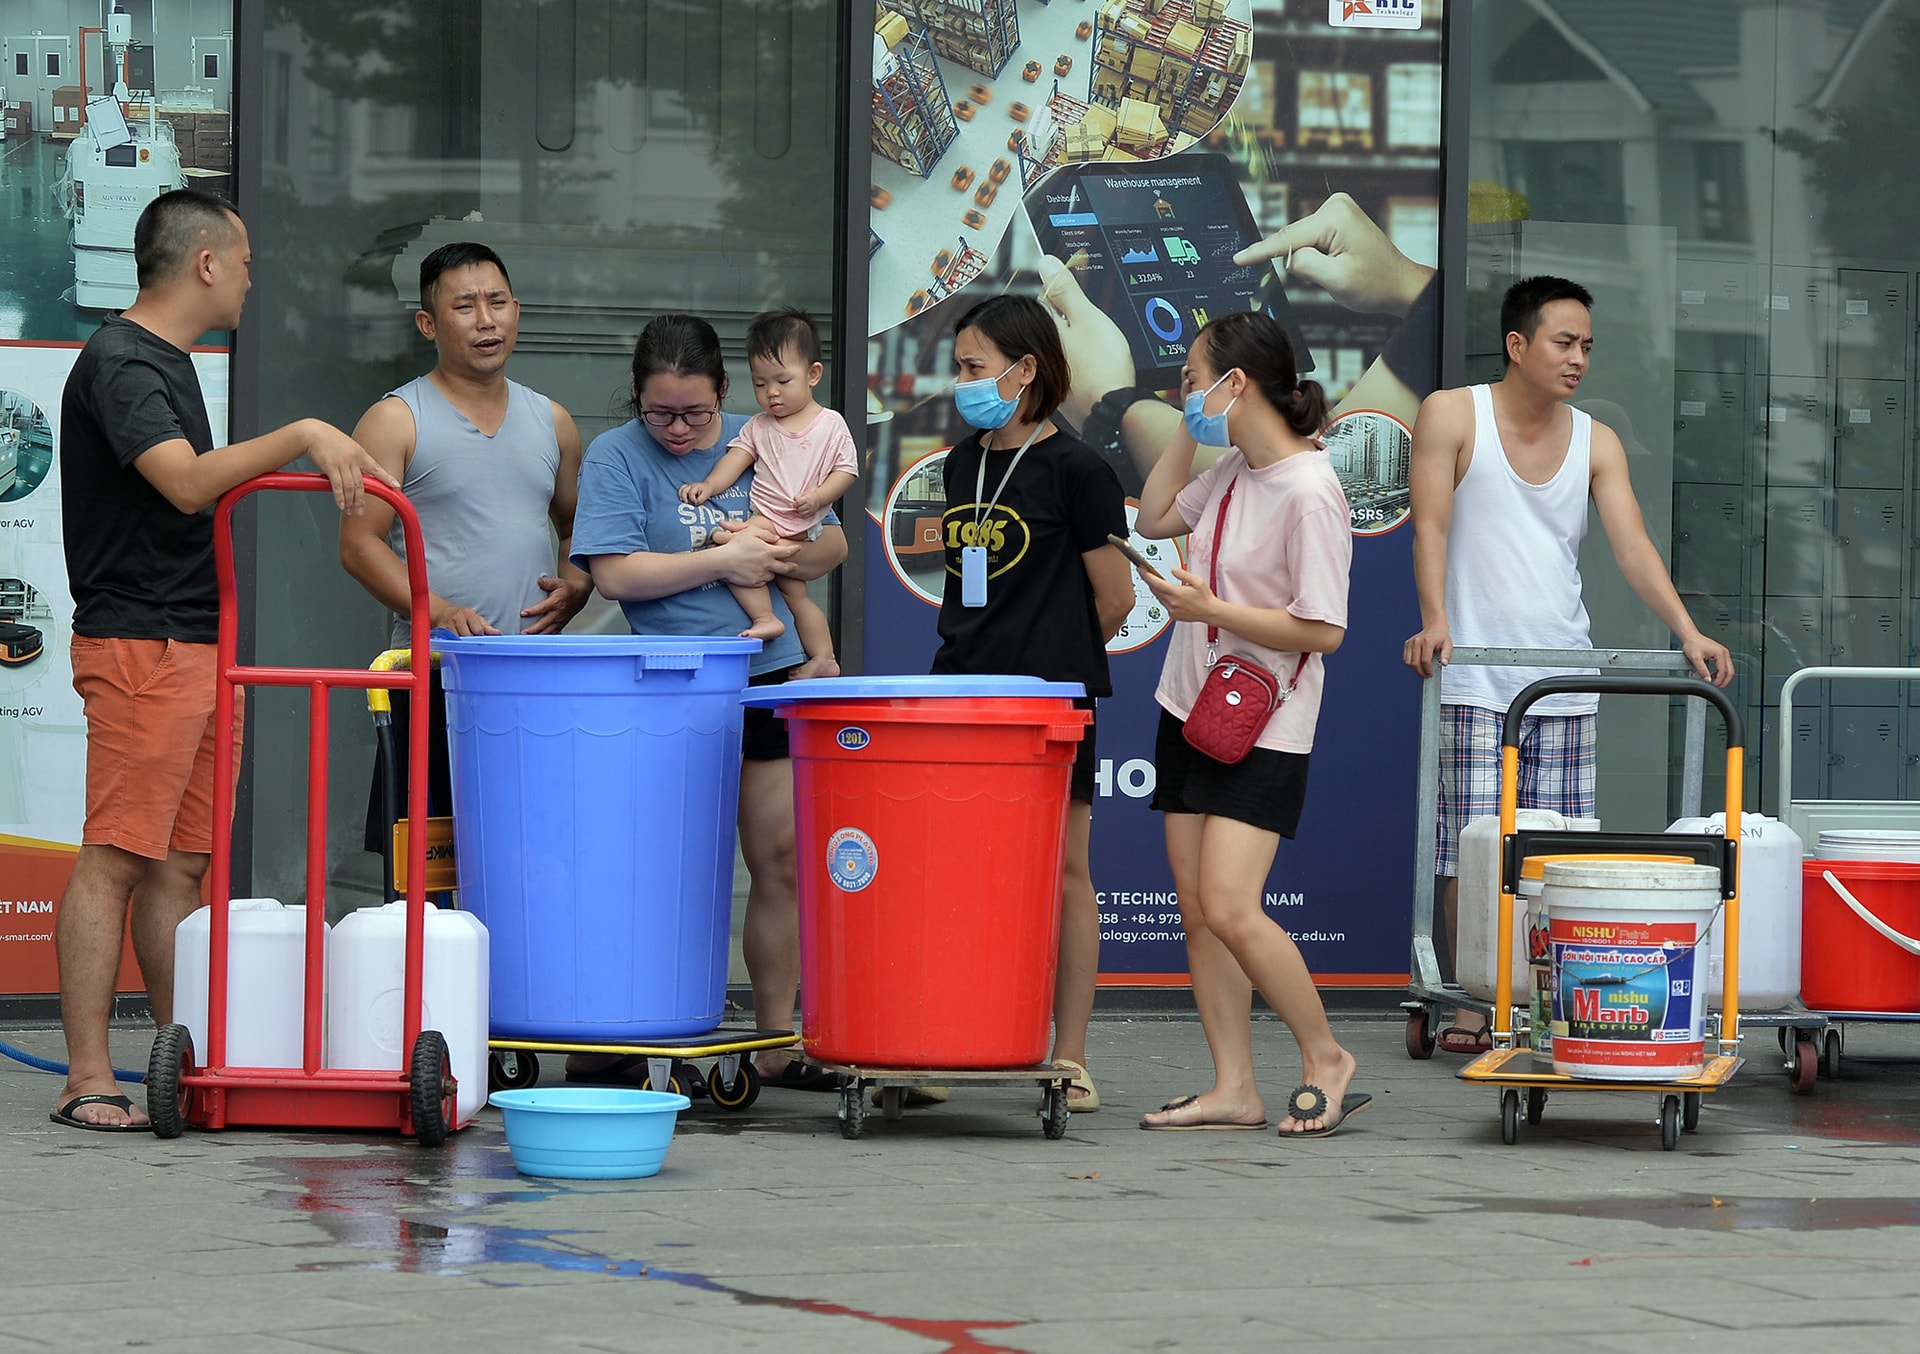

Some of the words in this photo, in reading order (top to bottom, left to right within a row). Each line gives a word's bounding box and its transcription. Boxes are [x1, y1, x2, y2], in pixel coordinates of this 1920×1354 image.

[1104, 178, 1150, 189] Warehouse
[1150, 176, 1202, 189] management
[1046, 193, 1081, 203] Dashbod
[1185, 271, 1195, 279] 23
[1166, 344, 1187, 355] 25%
[1350, 509, 1384, 520] ASRS
[0, 520, 10, 528] or
[13, 519, 35, 528] AGV
[946, 519, 1008, 552] 1985
[22, 707, 43, 716] AGV
[841, 732, 866, 745] 120L
[1111, 892, 1178, 905] TECHNO
[1266, 893, 1304, 906] NAM
[16, 900, 53, 914] NAM
[1131, 913, 1155, 924] +84
[1158, 913, 1182, 924] 979
[1099, 929, 1187, 943] ology.com.vn
[1573, 926, 1616, 938] NISHU
[1624, 955, 1644, 963] CAO
[1609, 990, 1649, 1004] nishu
[1573, 988, 1649, 1024] Marb
[1573, 1022, 1648, 1031] interior
[1653, 1031, 1665, 1039] JIS
